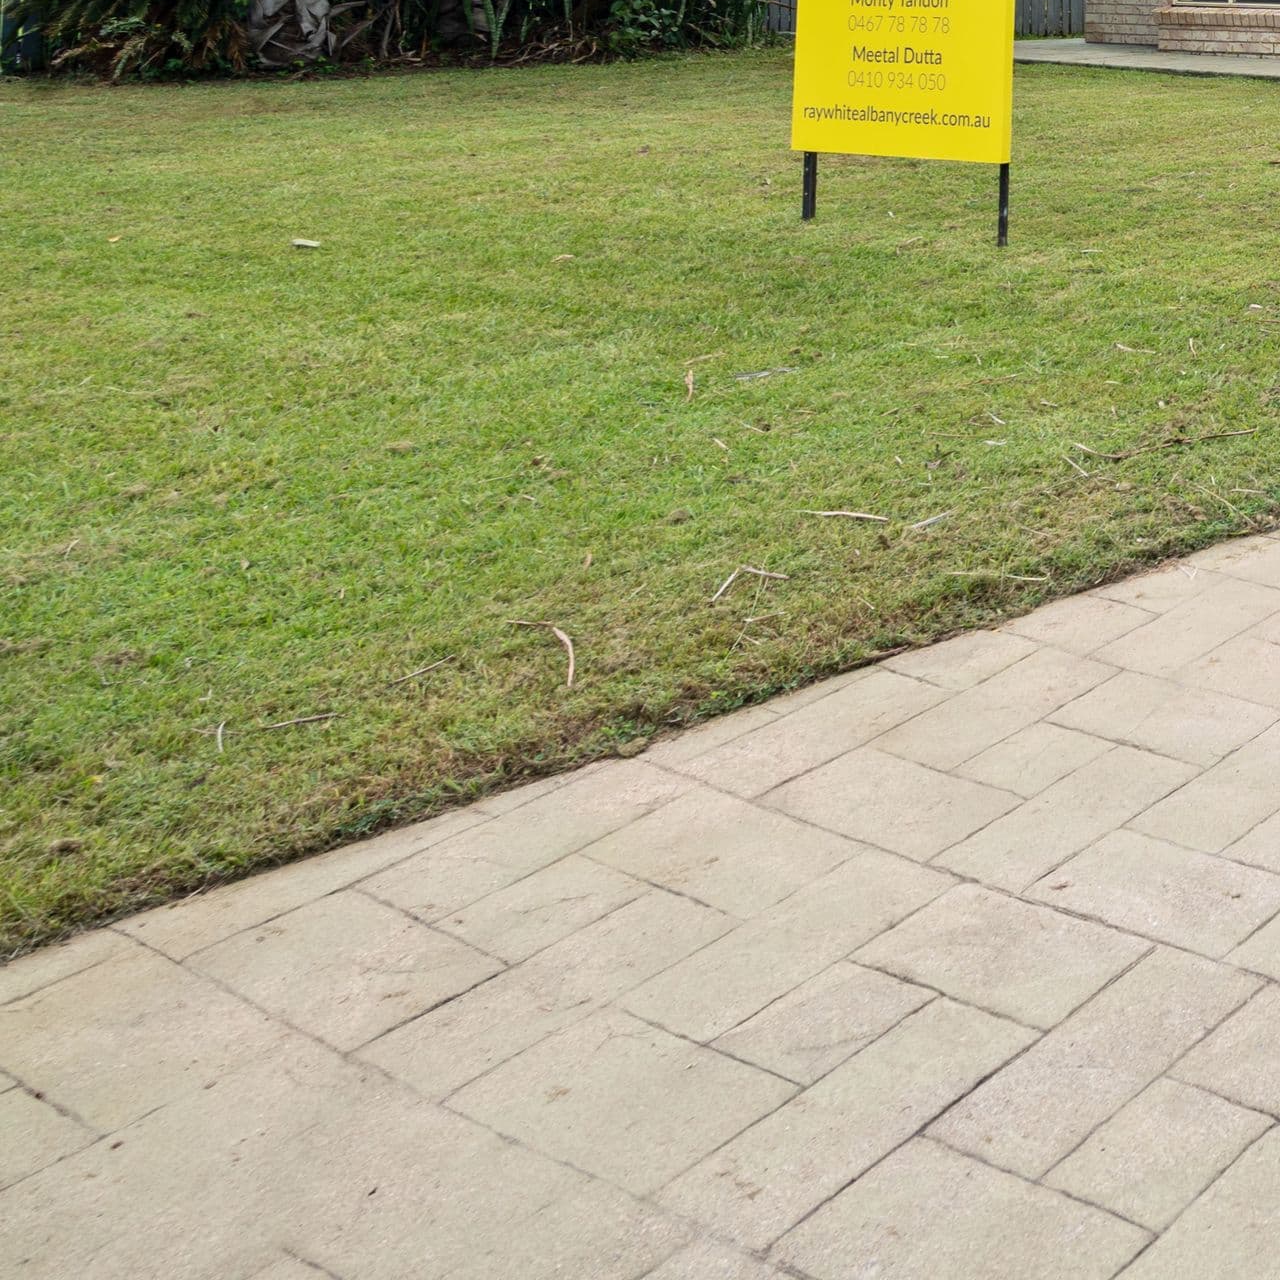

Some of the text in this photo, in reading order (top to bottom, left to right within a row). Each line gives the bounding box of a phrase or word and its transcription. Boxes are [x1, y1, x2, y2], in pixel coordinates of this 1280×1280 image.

[848, 15, 950, 34] 0467 78 78 78
[852, 46, 943, 65] Meetal Dutta
[847, 71, 946, 91] 0410 934 050
[803, 104, 990, 128] raywhitealbanycreek.com.au
